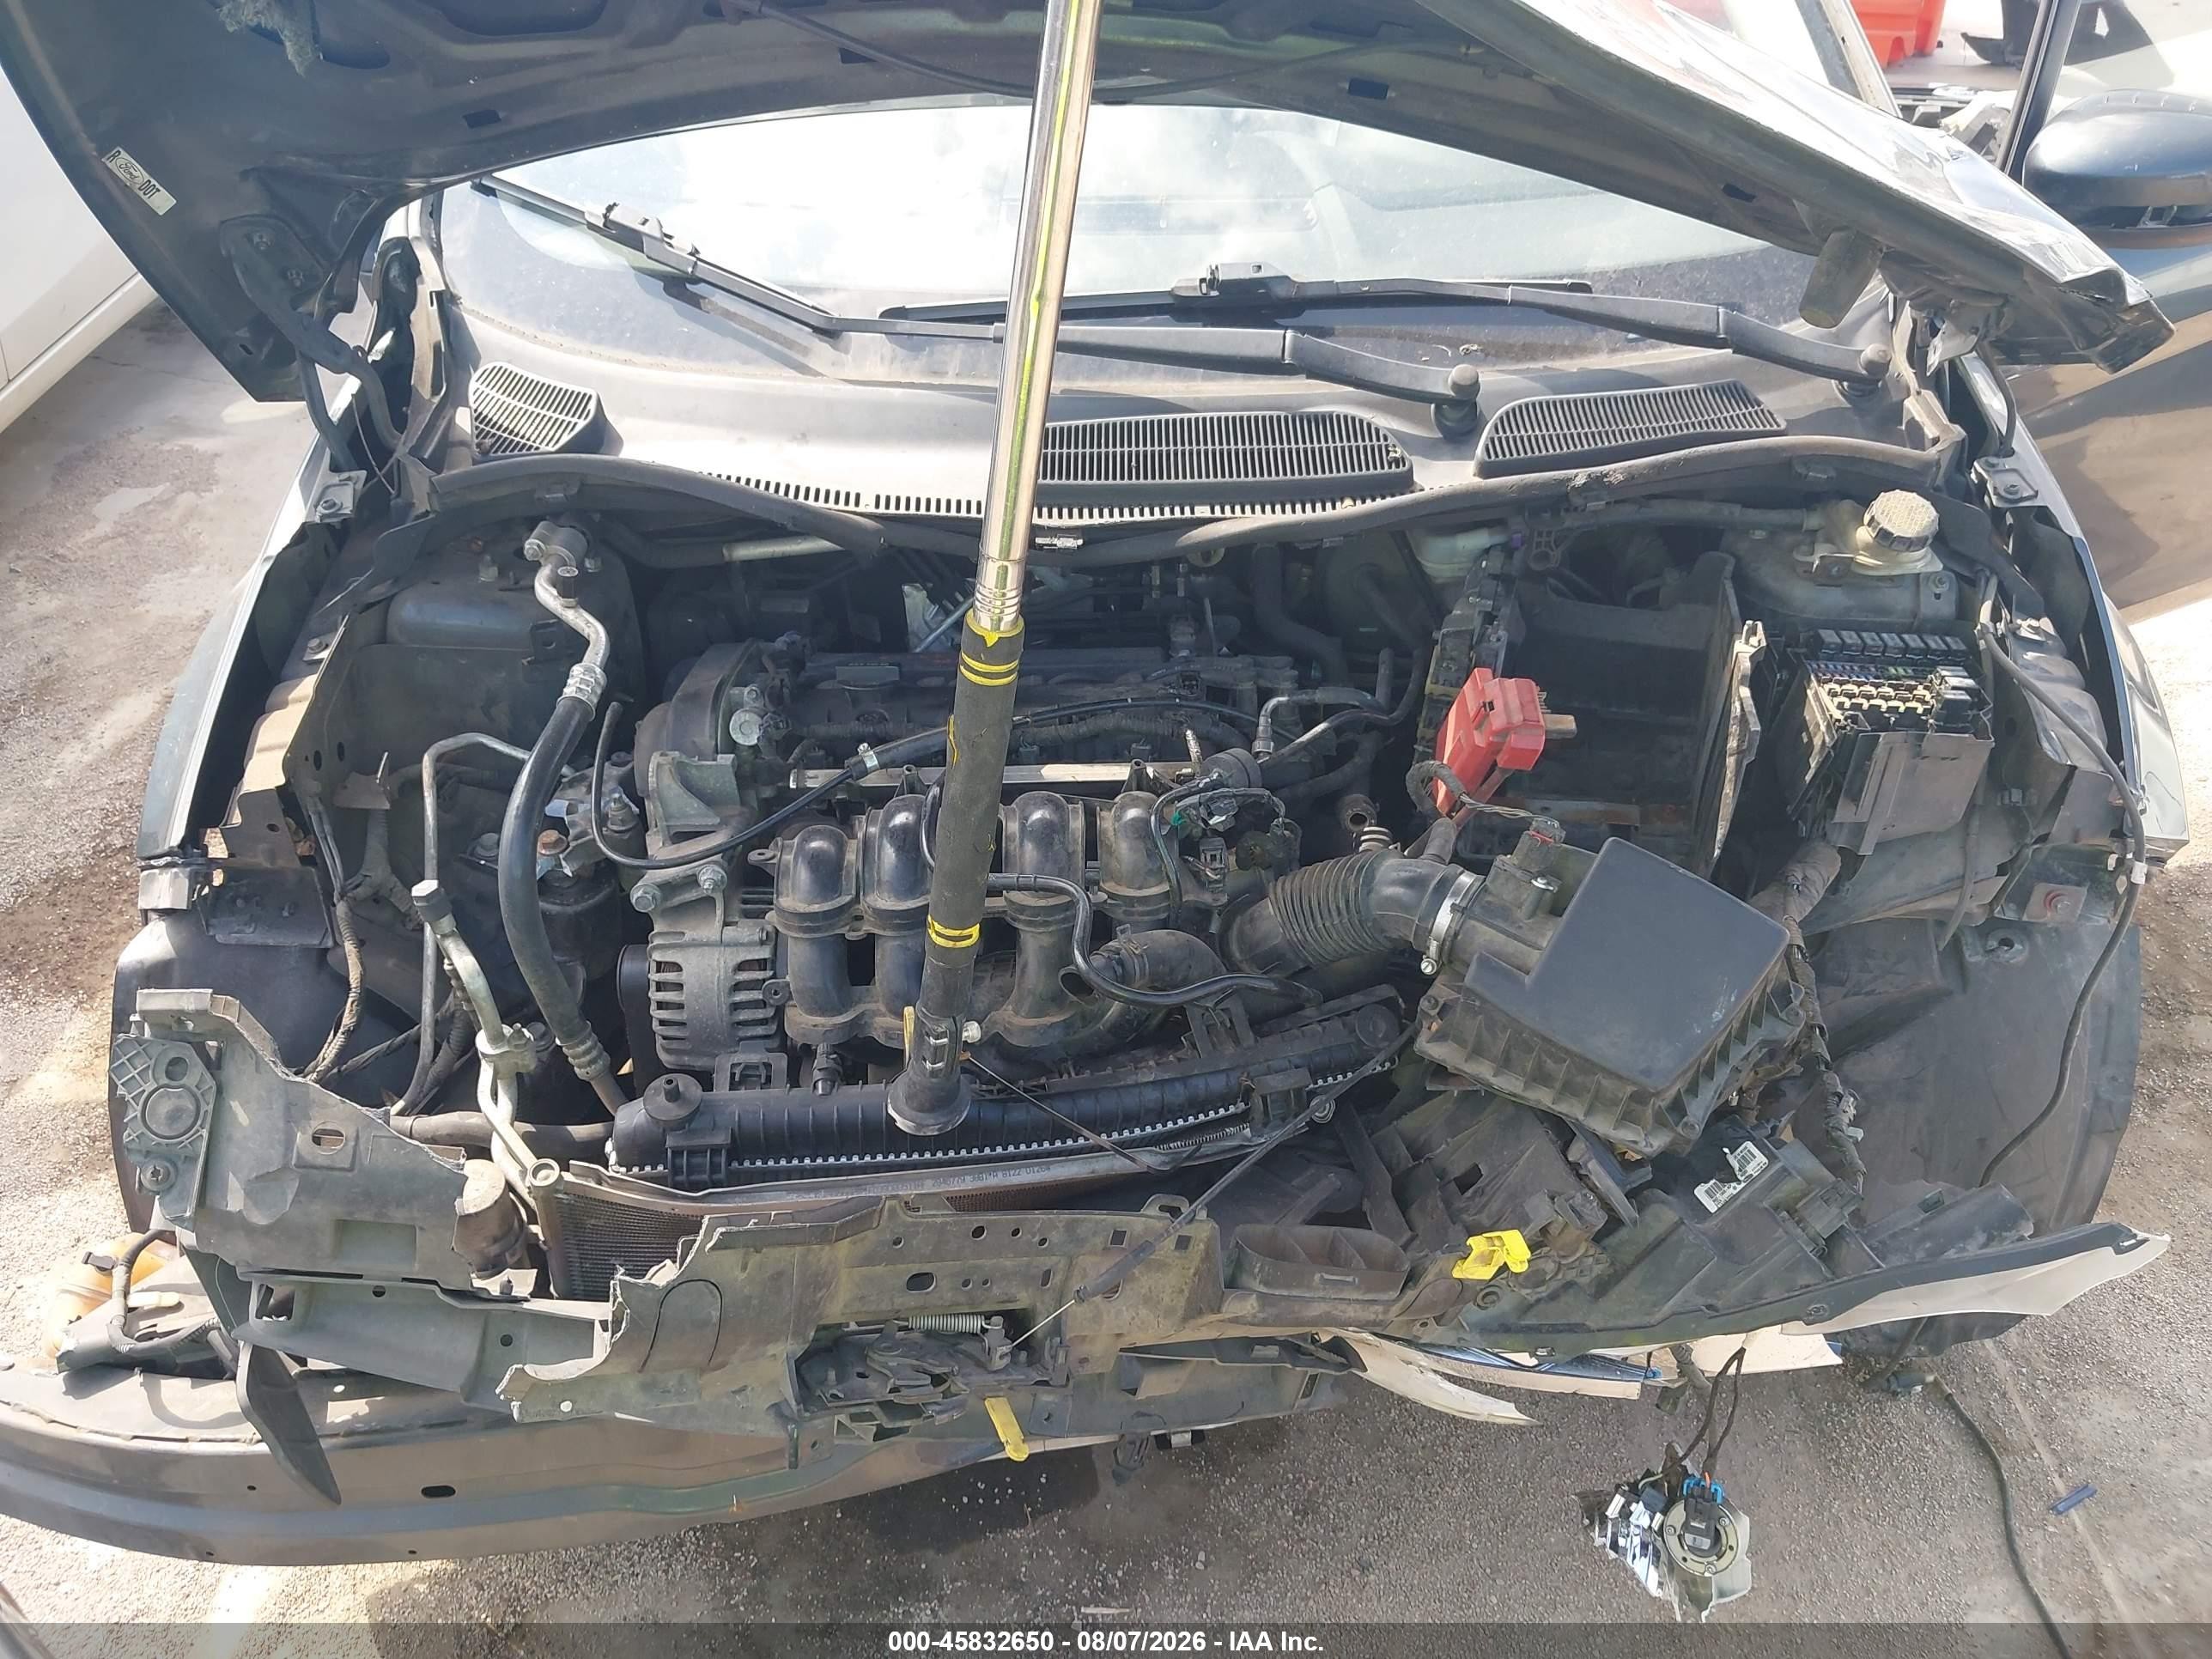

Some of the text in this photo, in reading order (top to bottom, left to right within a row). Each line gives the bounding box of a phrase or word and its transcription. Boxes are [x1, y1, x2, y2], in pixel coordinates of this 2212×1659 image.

[107, 149, 161, 199] R Ford DOT
